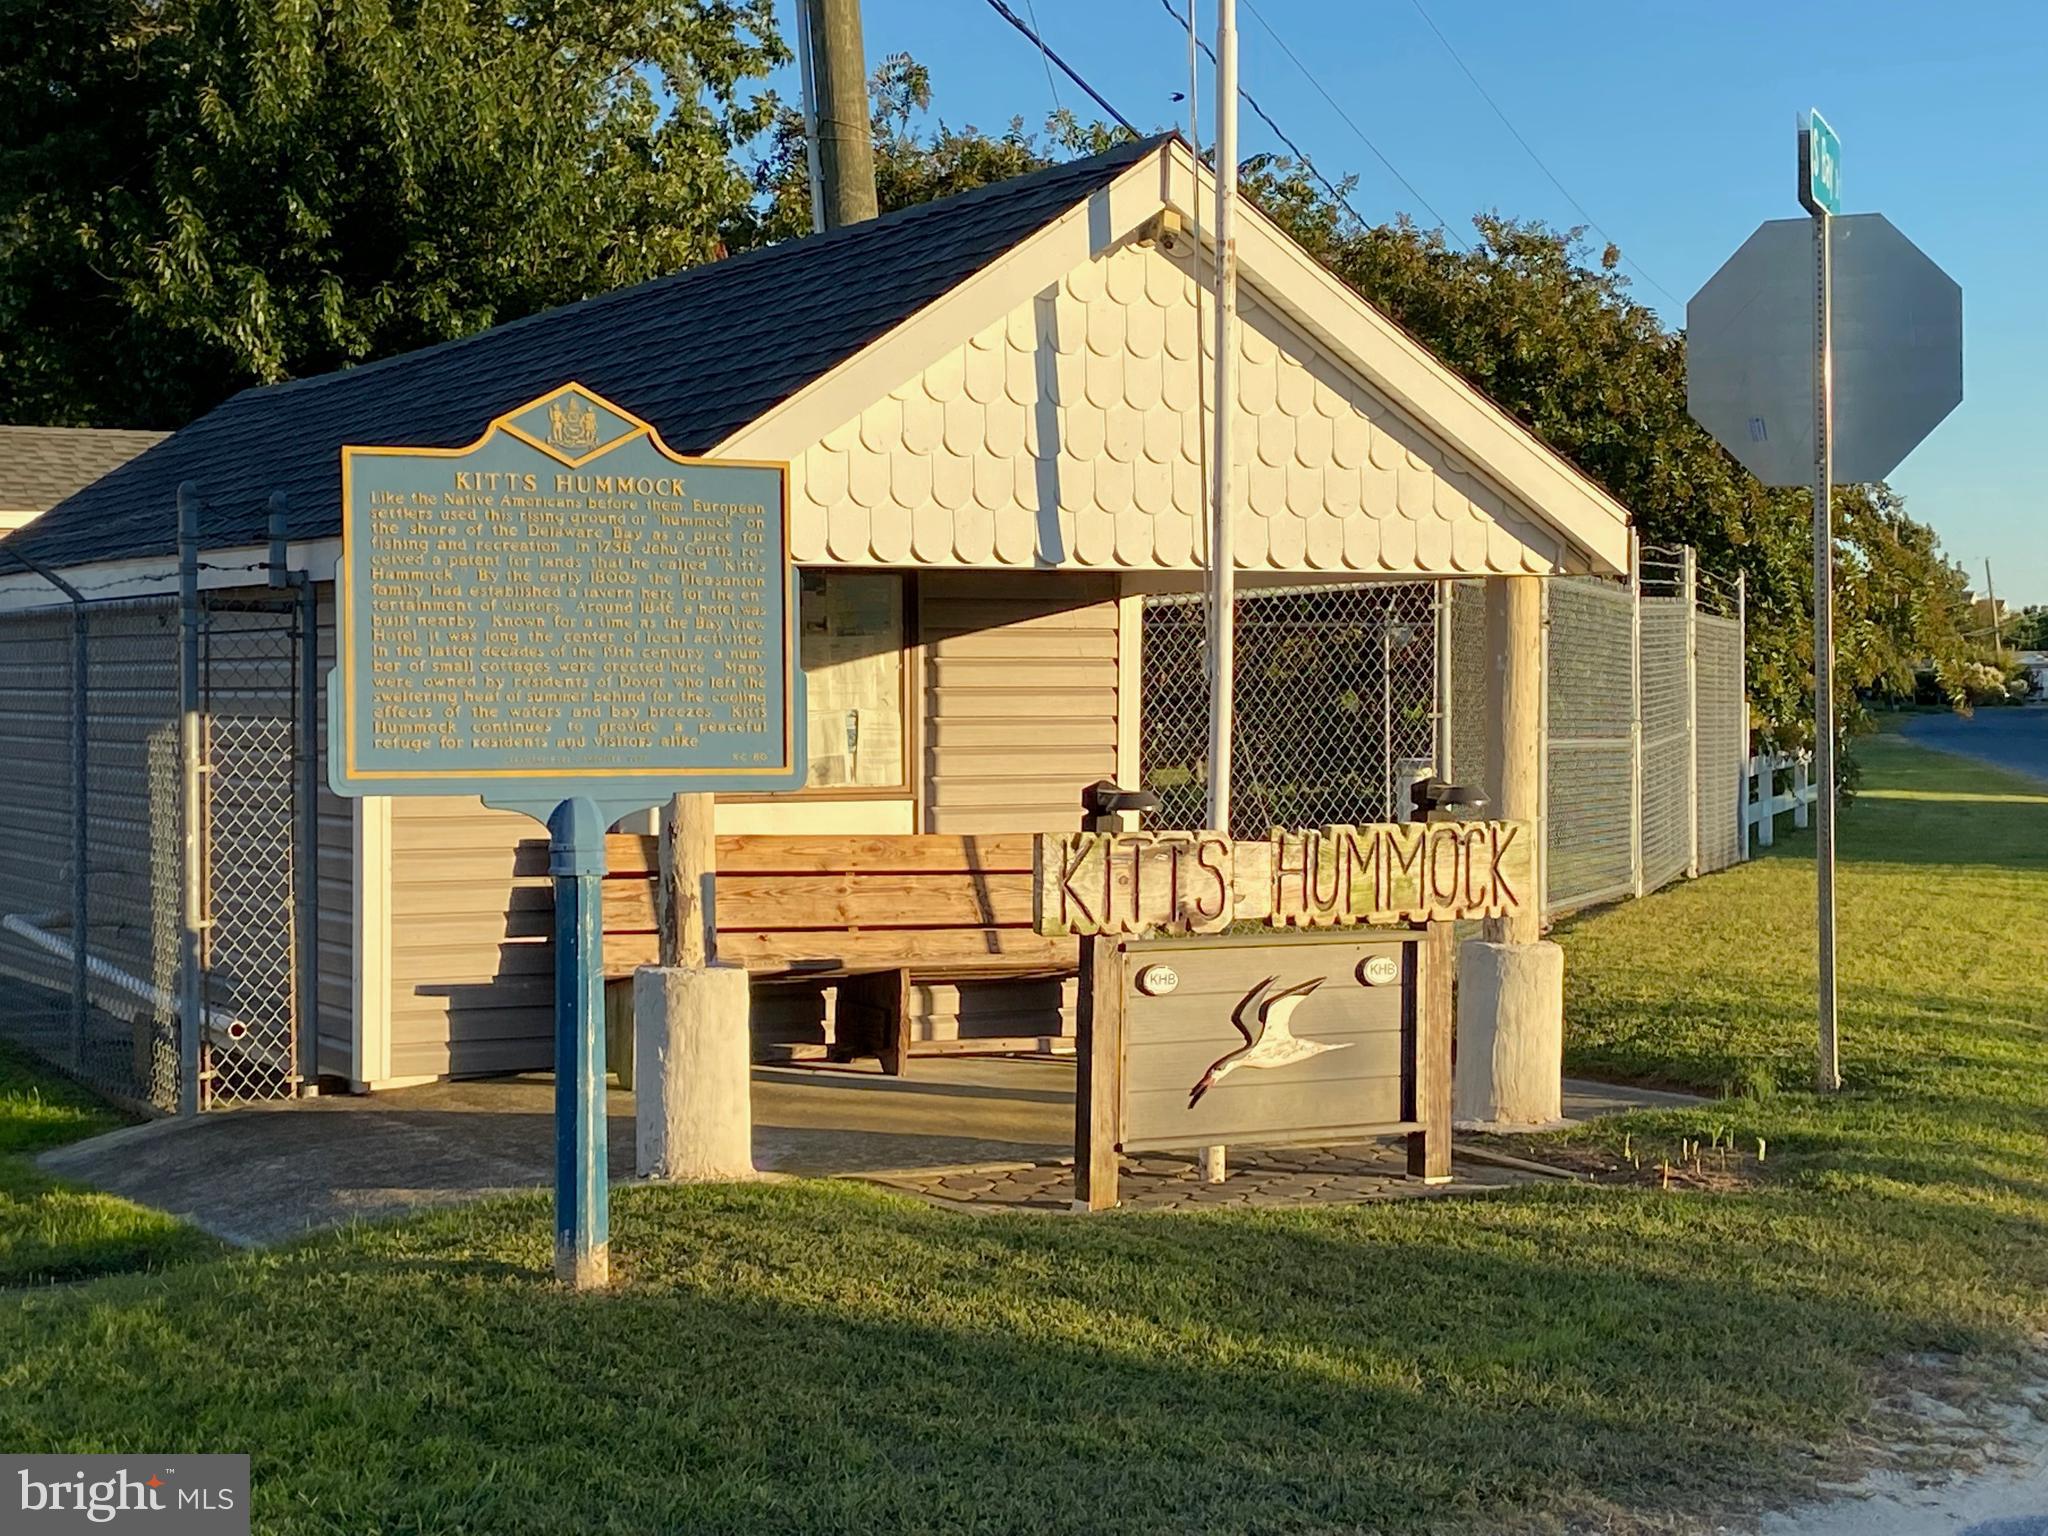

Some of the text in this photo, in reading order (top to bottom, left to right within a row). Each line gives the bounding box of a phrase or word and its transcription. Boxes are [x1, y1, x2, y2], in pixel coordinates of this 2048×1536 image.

[455, 472, 687, 497] KITTS HUMMOCK
[675, 532, 684, 542] a
[430, 557, 443, 567] a
[565, 590, 577, 600] a
[682, 606, 693, 616] a
[581, 620, 593, 629] a
[712, 650, 724, 660] a
[673, 724, 684, 733] a
[1057, 825, 1520, 927] KITTS HUMMOCK
[1369, 962, 1396, 976] KHB
[1148, 972, 1177, 987] KHB
